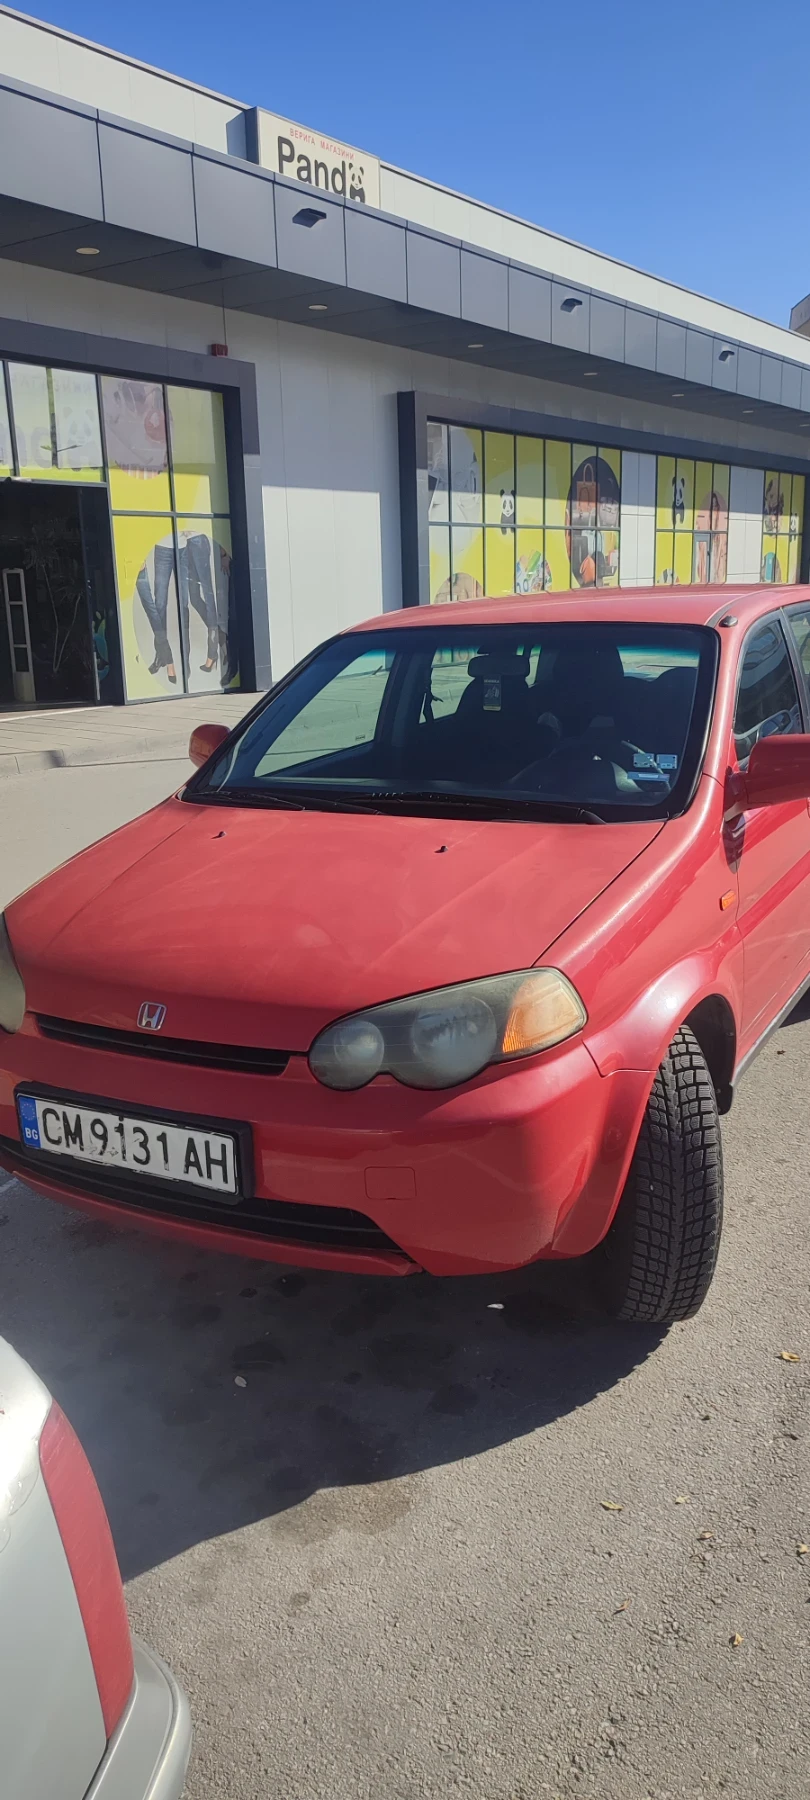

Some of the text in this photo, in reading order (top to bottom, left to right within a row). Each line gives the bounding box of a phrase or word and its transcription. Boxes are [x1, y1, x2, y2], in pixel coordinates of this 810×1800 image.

[289, 128, 355, 160] ВЕРИГА МАГАЗИНИ
[25, 1127, 39, 1141] BG
